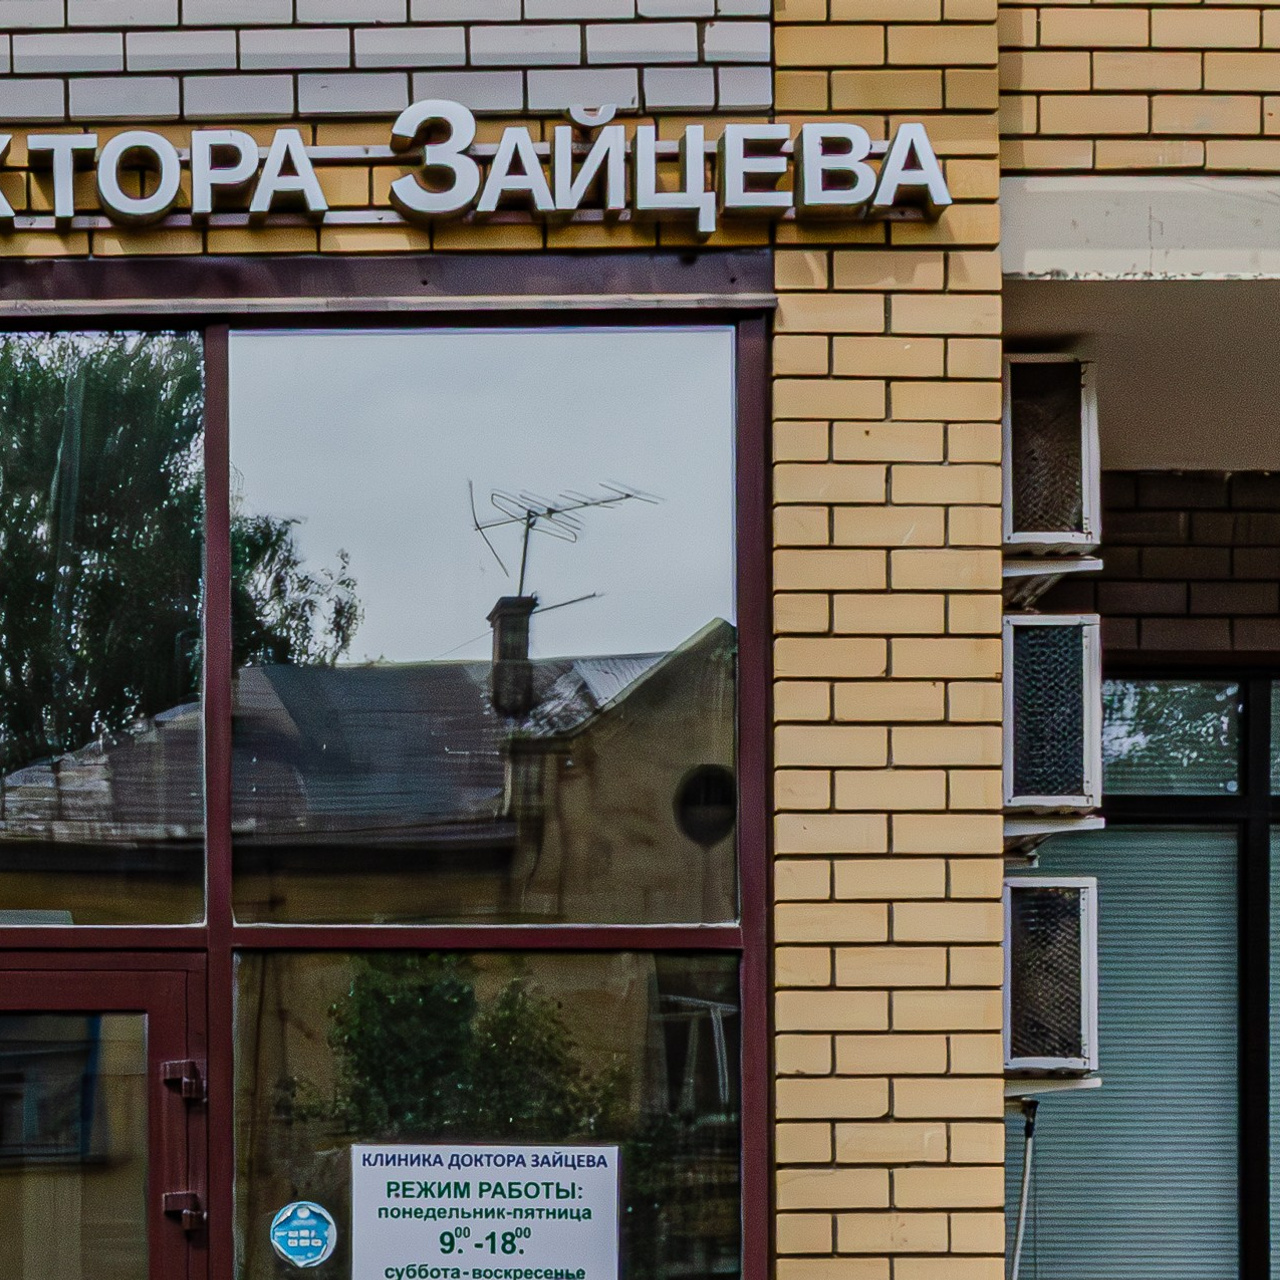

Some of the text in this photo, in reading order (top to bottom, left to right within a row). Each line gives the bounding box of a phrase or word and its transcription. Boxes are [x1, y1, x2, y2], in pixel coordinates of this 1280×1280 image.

[362, 1151, 608, 1171] КЛИНИКА ДОКТОРА ЗАЙЦЕВА
[386, 1180, 583, 1200] РЕЖИМ РАБОТЫ:
[377, 1206, 592, 1223] понедельник-пятница
